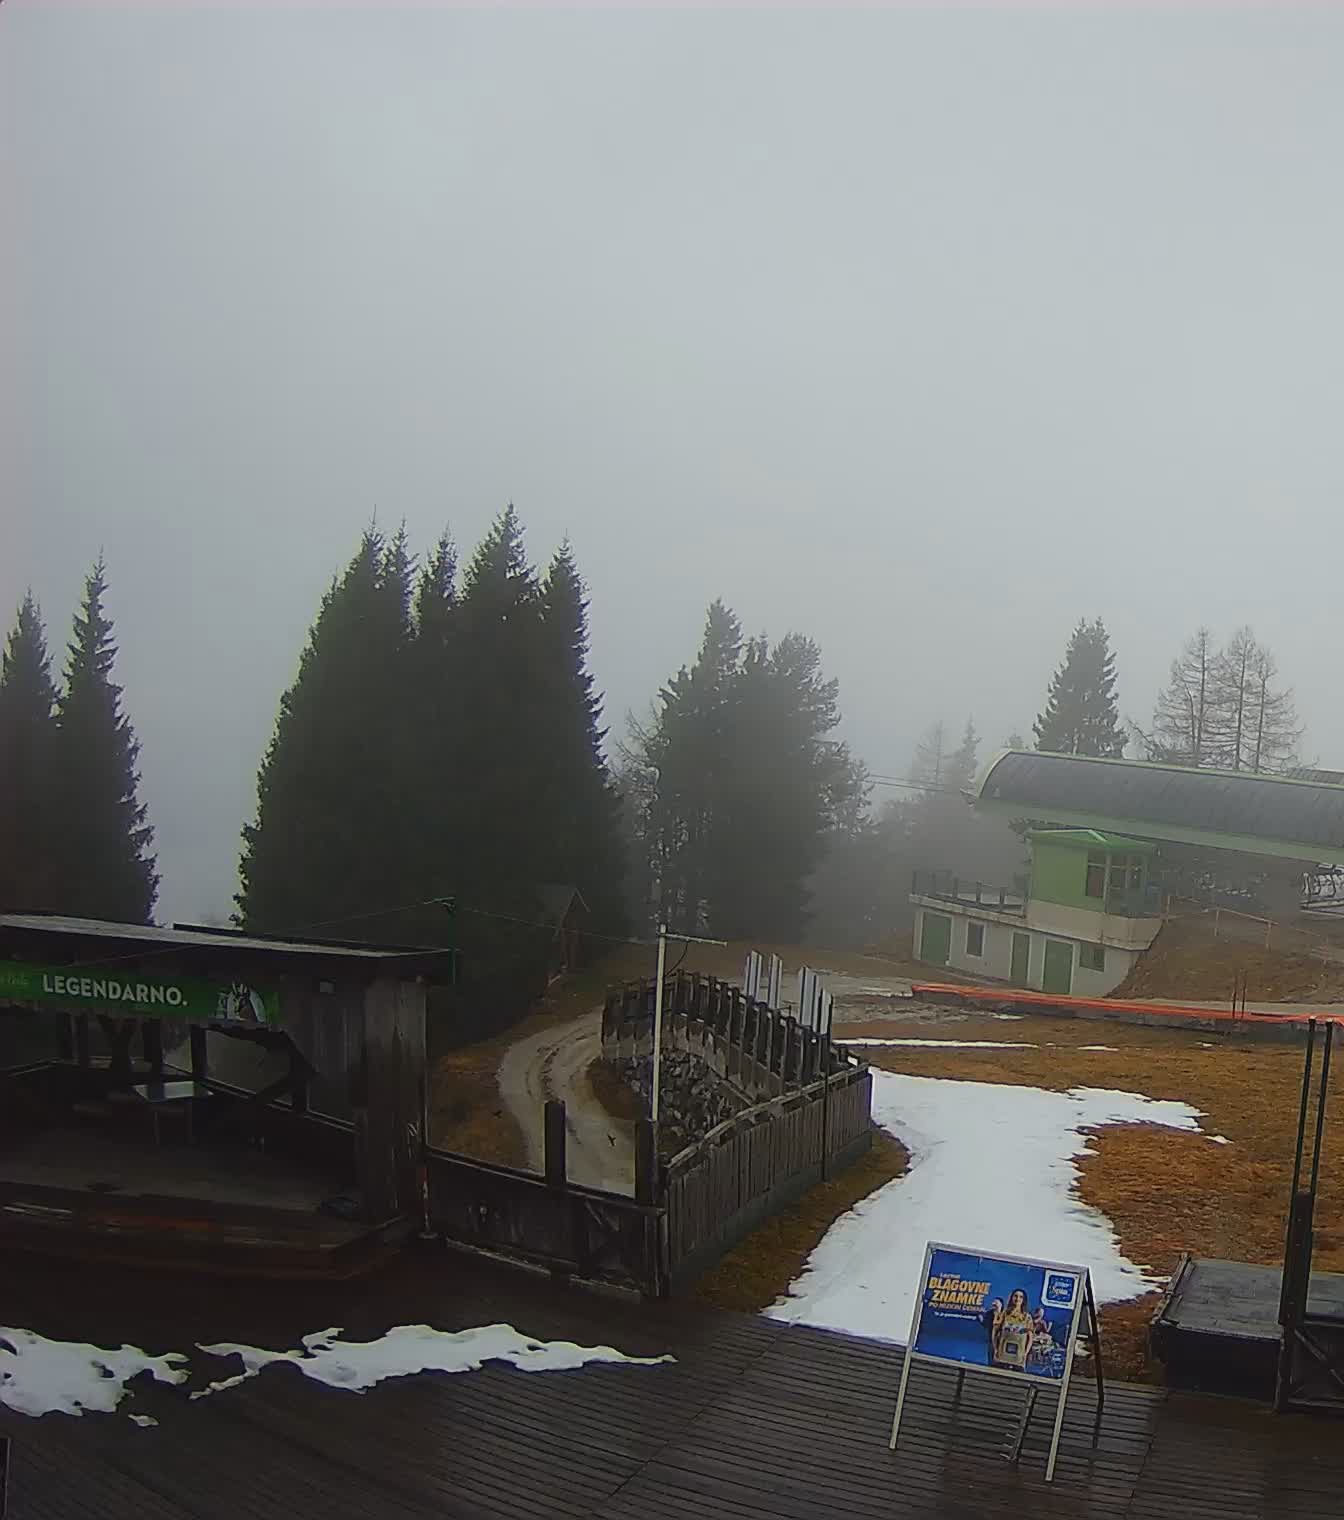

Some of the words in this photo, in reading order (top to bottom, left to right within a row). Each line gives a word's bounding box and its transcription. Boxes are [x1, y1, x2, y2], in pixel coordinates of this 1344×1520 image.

[42, 973, 189, 1006] LEGENDARNO.
[928, 1276, 991, 1295] BLAGOVNE
[931, 1289, 985, 1306] ZNAMKE
